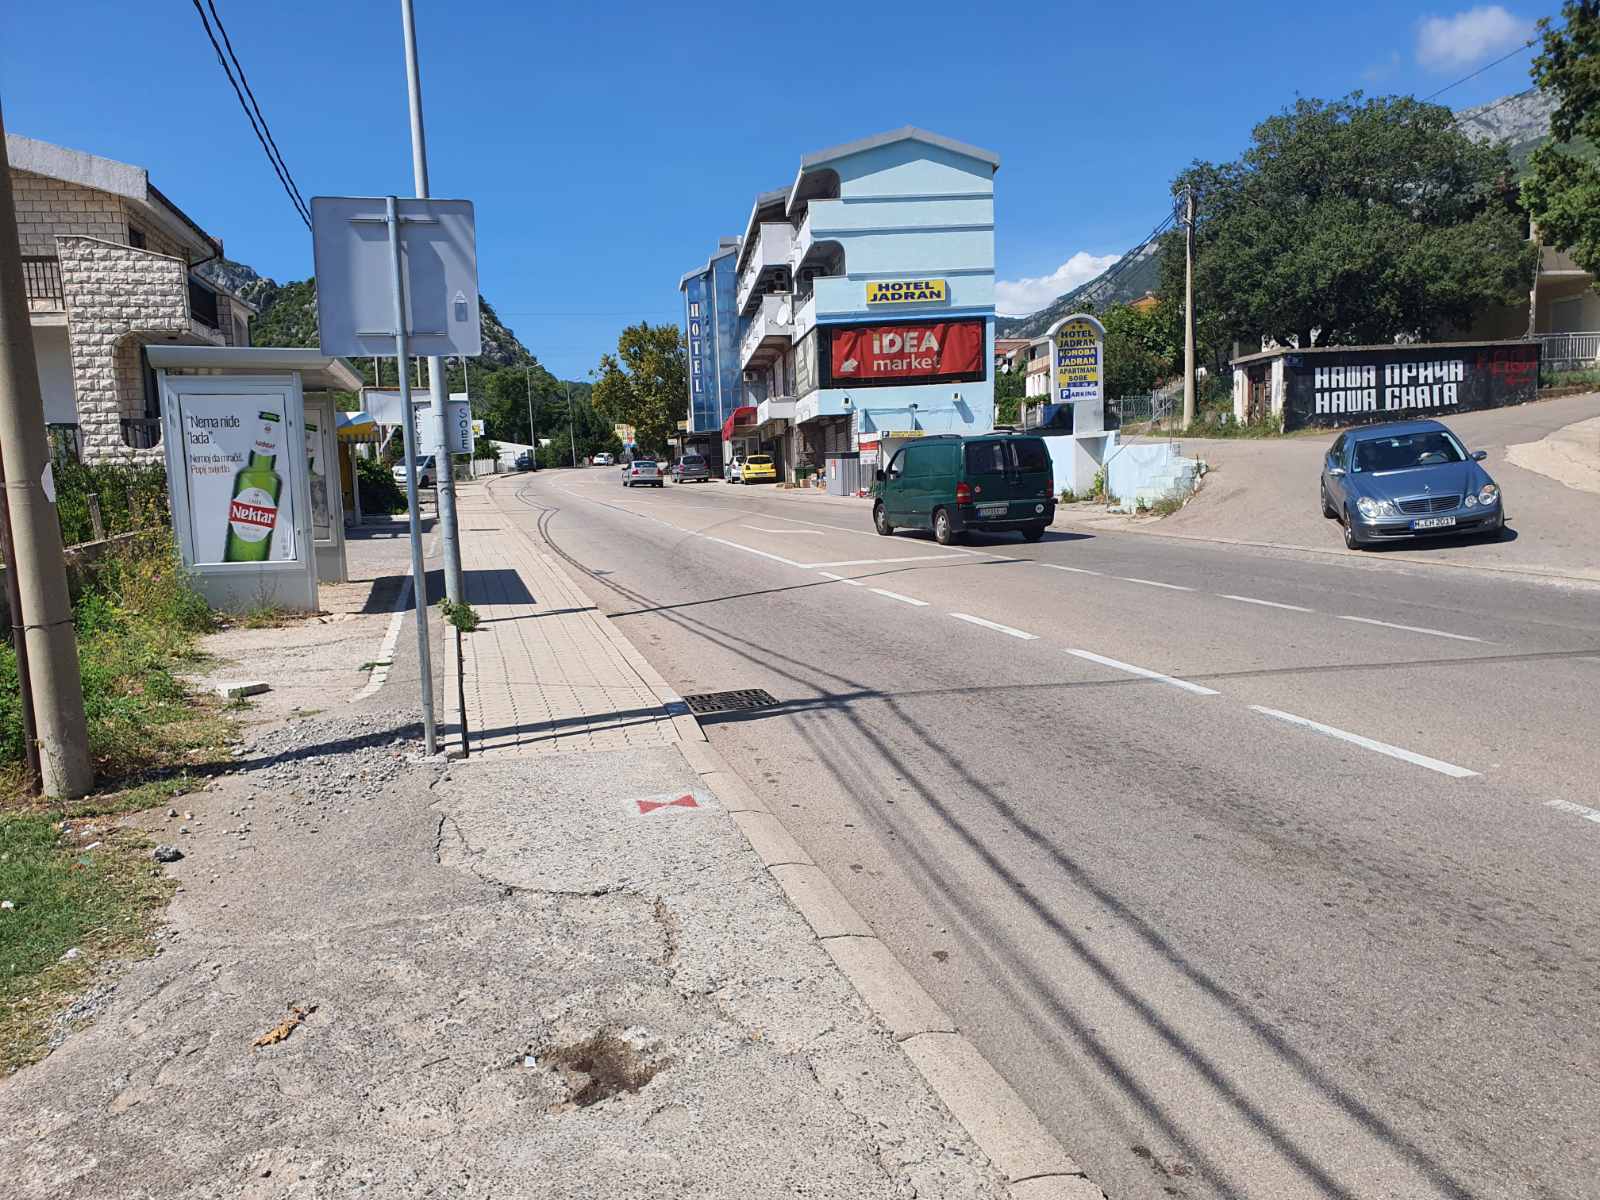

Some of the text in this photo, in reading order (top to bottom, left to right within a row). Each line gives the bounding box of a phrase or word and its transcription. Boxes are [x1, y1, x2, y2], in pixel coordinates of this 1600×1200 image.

[878, 281, 935, 292] HOTEL
[870, 290, 942, 302] JADRAN
[1060, 330, 1094, 339] HOTEL
[690, 303, 702, 393] HOTEL
[1060, 338, 1096, 348] JADRAN
[1059, 348, 1096, 357] KONOBA
[872, 354, 942, 372] market
[1061, 357, 1095, 367] JADRAN
[1059, 366, 1097, 374] APARTMANI
[1314, 365, 1376, 389] НАША
[1384, 359, 1464, 387] ПРИЧА
[1068, 374, 1088, 382] SOBE
[1314, 383, 1459, 414] НАША СНАГА
[459, 408, 469, 449] SOBE
[232, 504, 275, 524] Nektar
